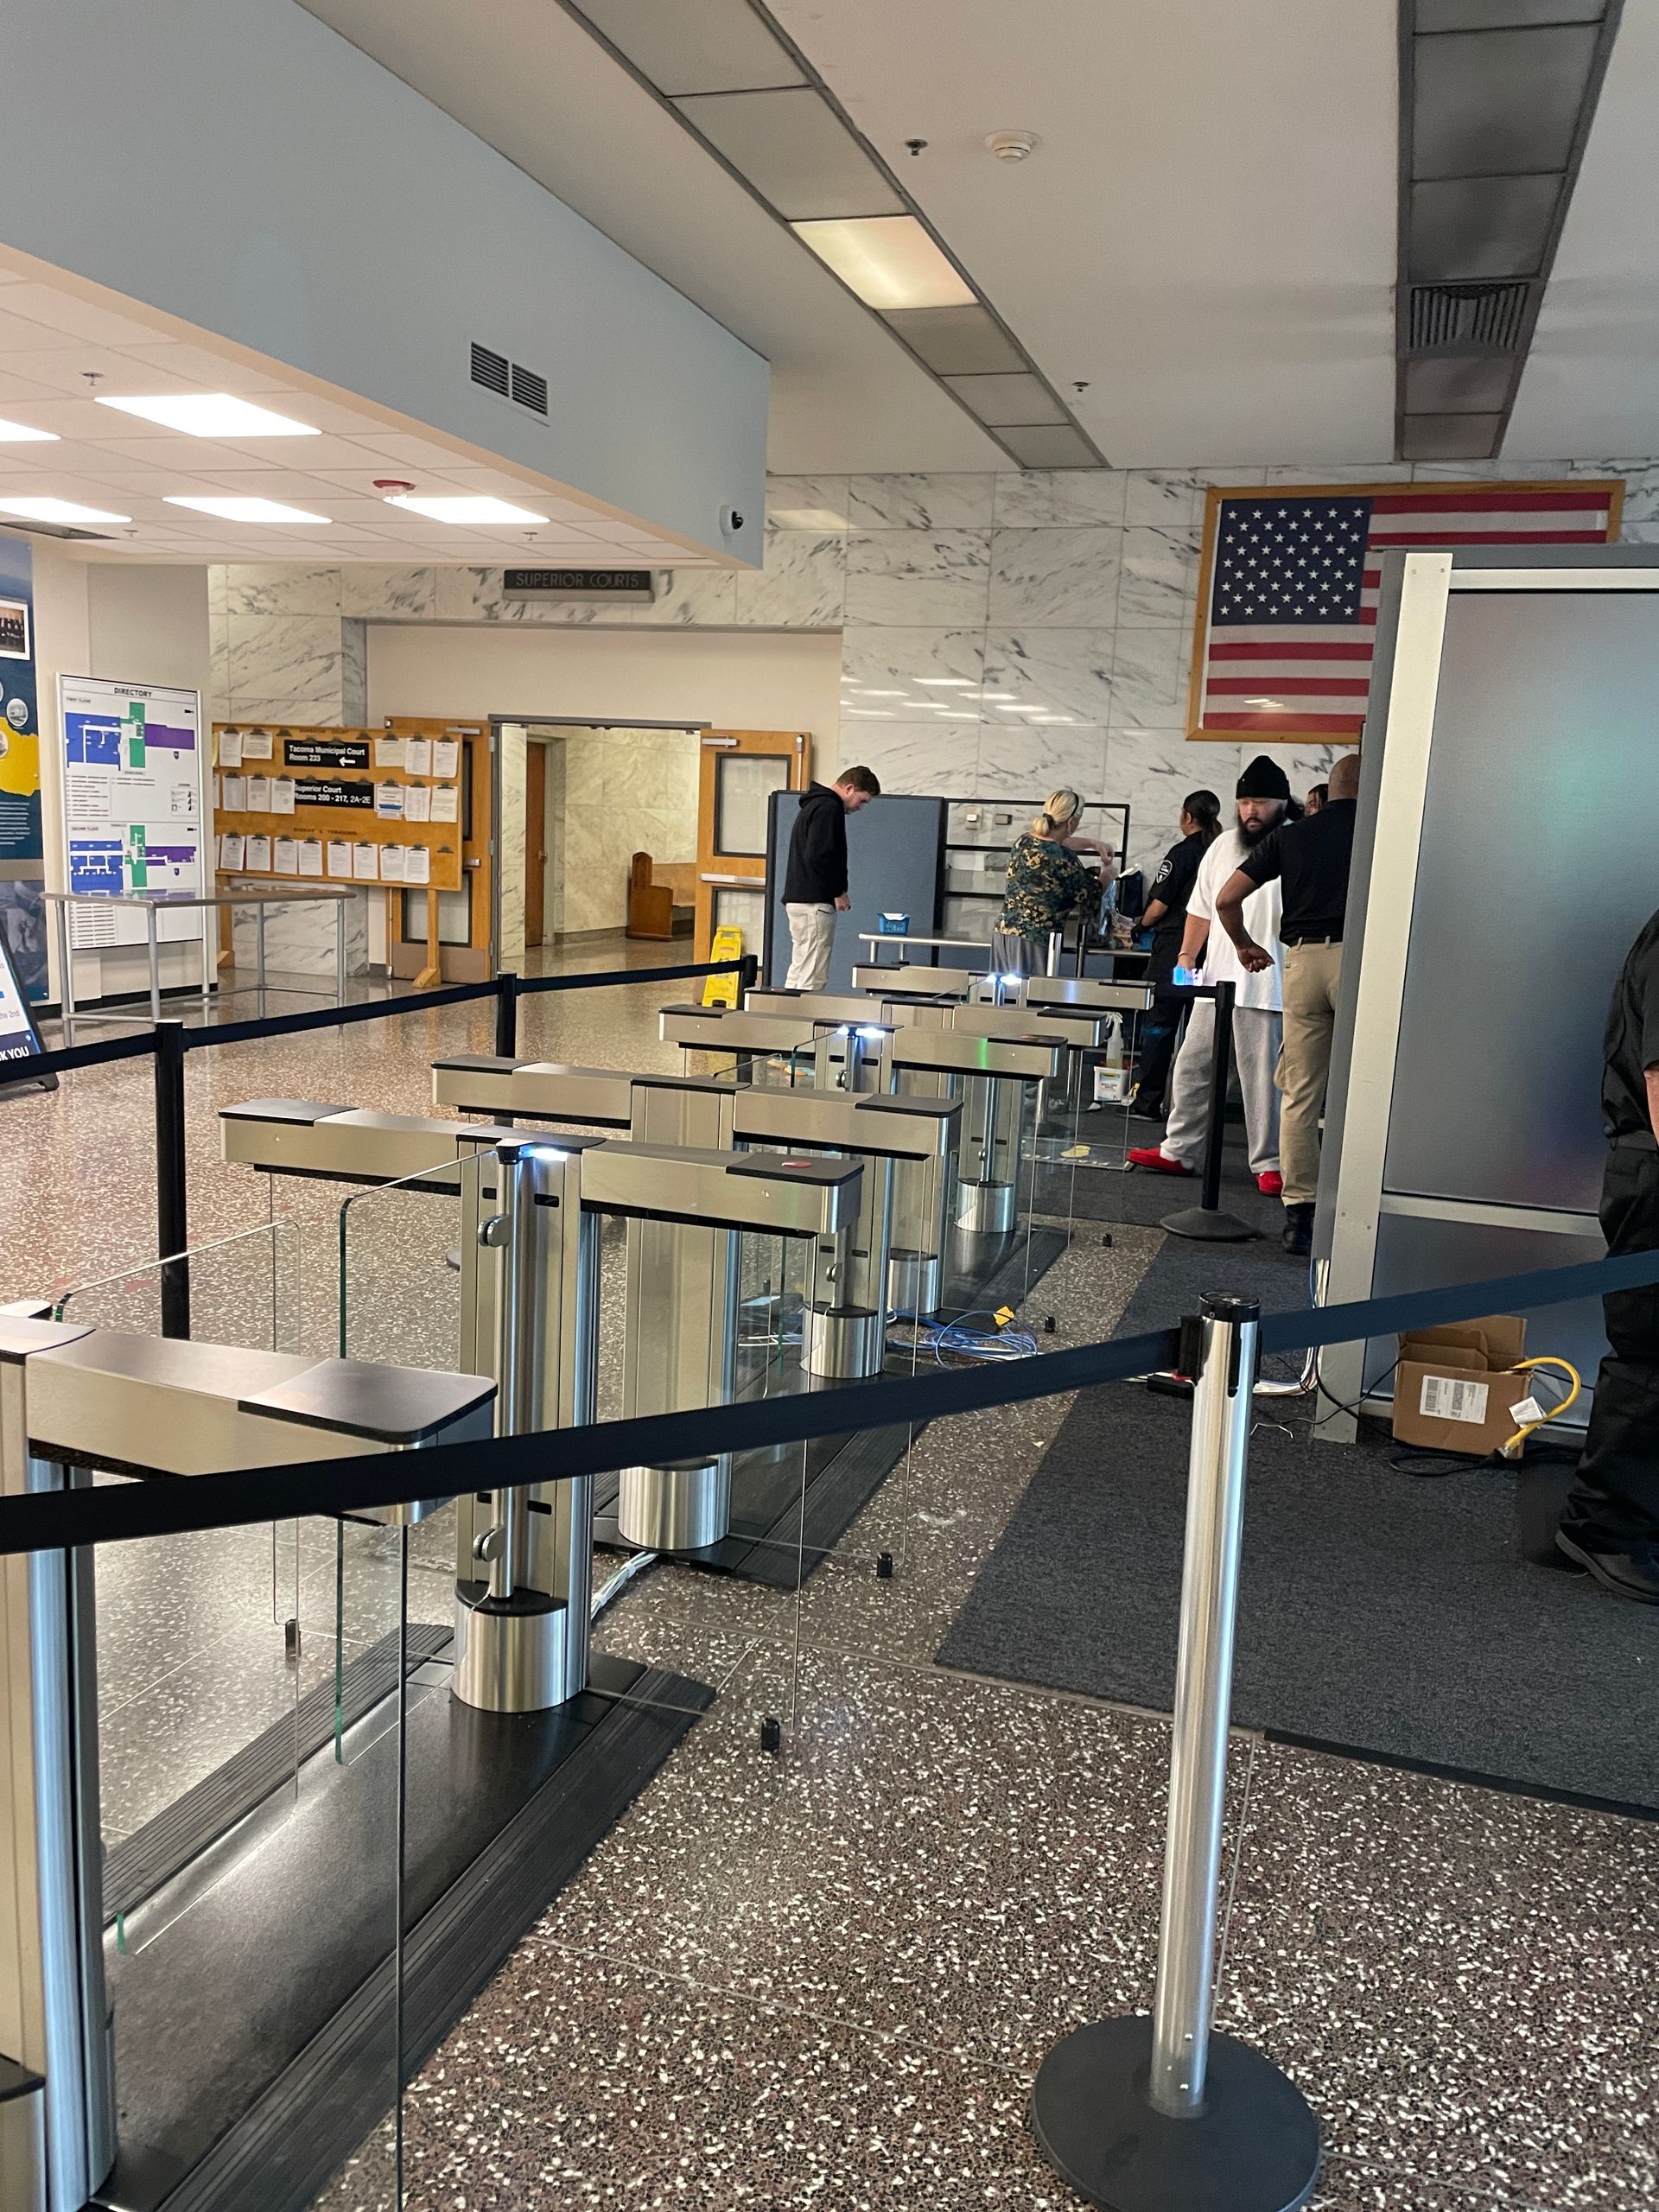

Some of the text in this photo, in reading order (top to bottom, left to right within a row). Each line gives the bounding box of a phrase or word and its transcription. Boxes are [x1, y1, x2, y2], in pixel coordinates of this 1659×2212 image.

[516, 572, 639, 588] SUPERIOR COURTS
[114, 687, 152, 697] DIRECTORY
[289, 745, 365, 756] Tacoma Municipal Court
[322, 785, 342, 794] Court
[334, 795, 349, 804] 217,
[349, 796, 372, 804] 2A-2E
[7, 1046, 29, 1059] YOU
